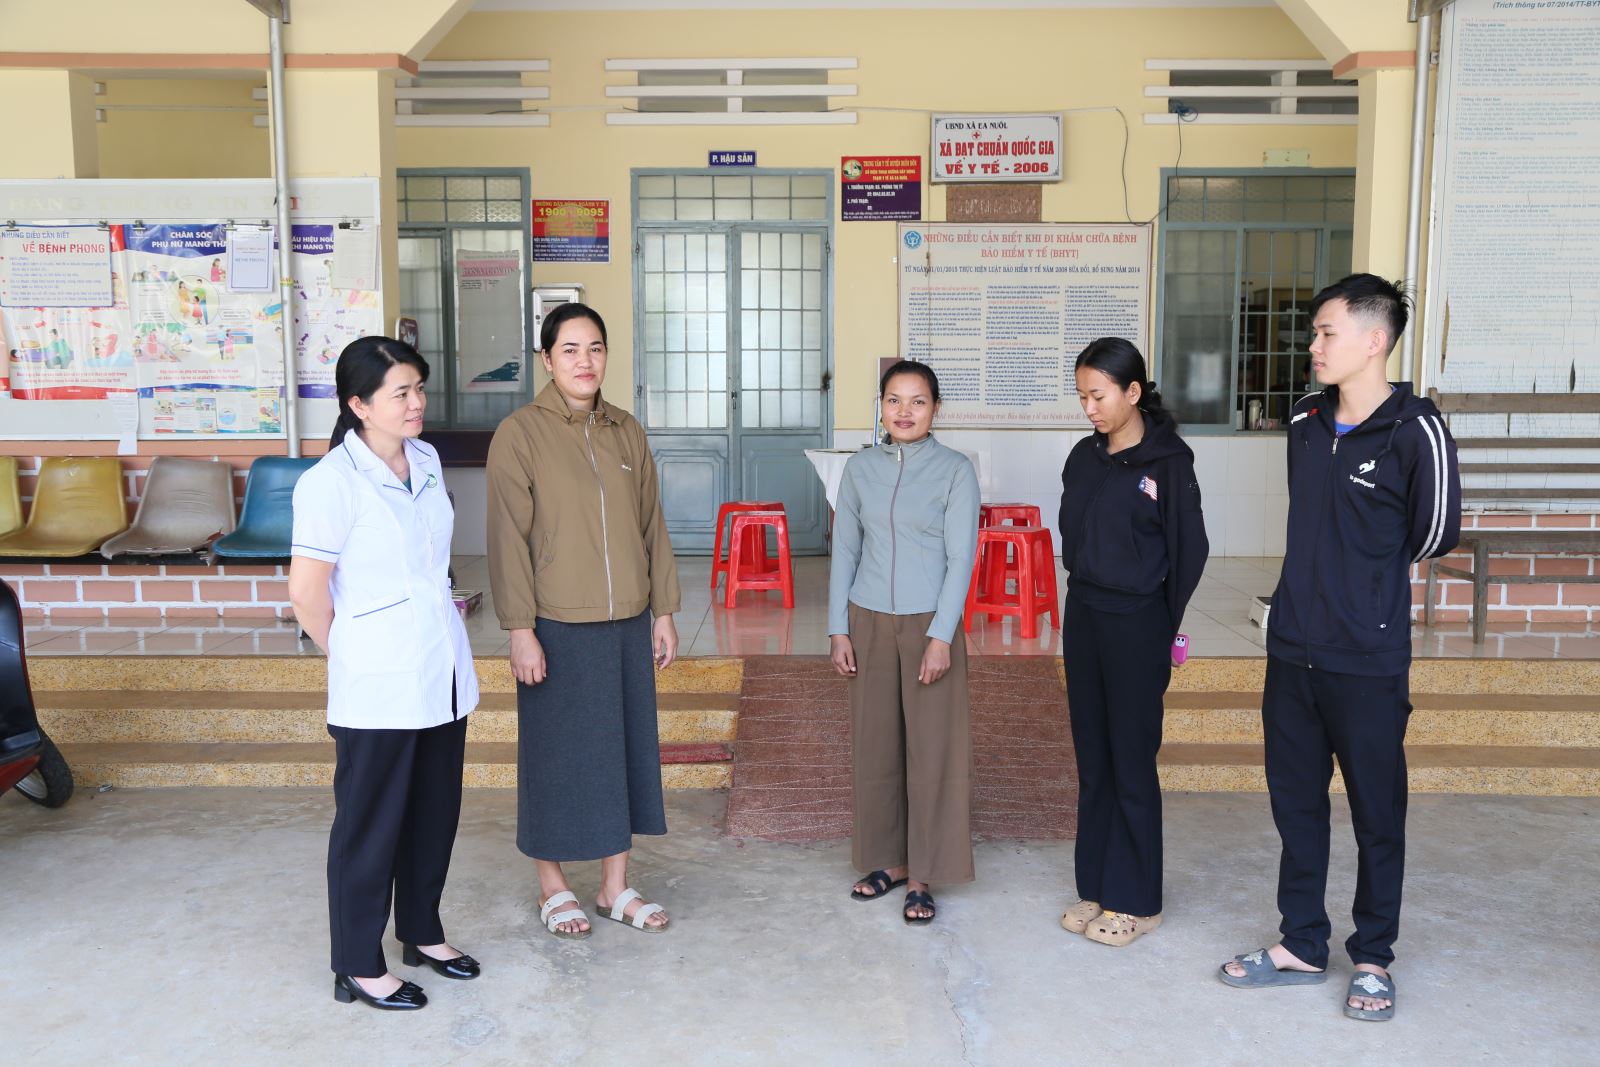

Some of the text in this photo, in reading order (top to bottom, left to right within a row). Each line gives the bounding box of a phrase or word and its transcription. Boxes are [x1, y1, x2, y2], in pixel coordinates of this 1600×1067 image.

[1515, 1, 1536, 10] thông
[956, 142, 974, 160] ĐẠT
[977, 134, 1008, 156] CHUẨN
[1012, 136, 1036, 157] QUỐC
[1039, 140, 1054, 155] GIA
[720, 153, 735, 164] HẬU
[737, 153, 753, 163] SẢN
[945, 160, 963, 174] VỀ
[968, 164, 976, 174] Y
[981, 159, 1000, 174] TẾ
[1014, 163, 1048, 173] 2006
[981, 230, 998, 243] CẦN
[1002, 231, 1022, 243] BIẾT
[1025, 234, 1041, 243] KHI
[1044, 234, 1054, 243] ĐI
[1056, 232, 1083, 243] KHÁM
[1086, 232, 1110, 243] CHỮA
[1113, 233, 1137, 245] BỆNH
[39, 242, 66, 256] BỆNH
[70, 244, 105, 253] PHONG
[981, 246, 999, 257] BẢO
[1002, 245, 1024, 257] HIỂM
[1036, 246, 1048, 257] TẾ
[1050, 249, 1079, 259] (BHYT)
